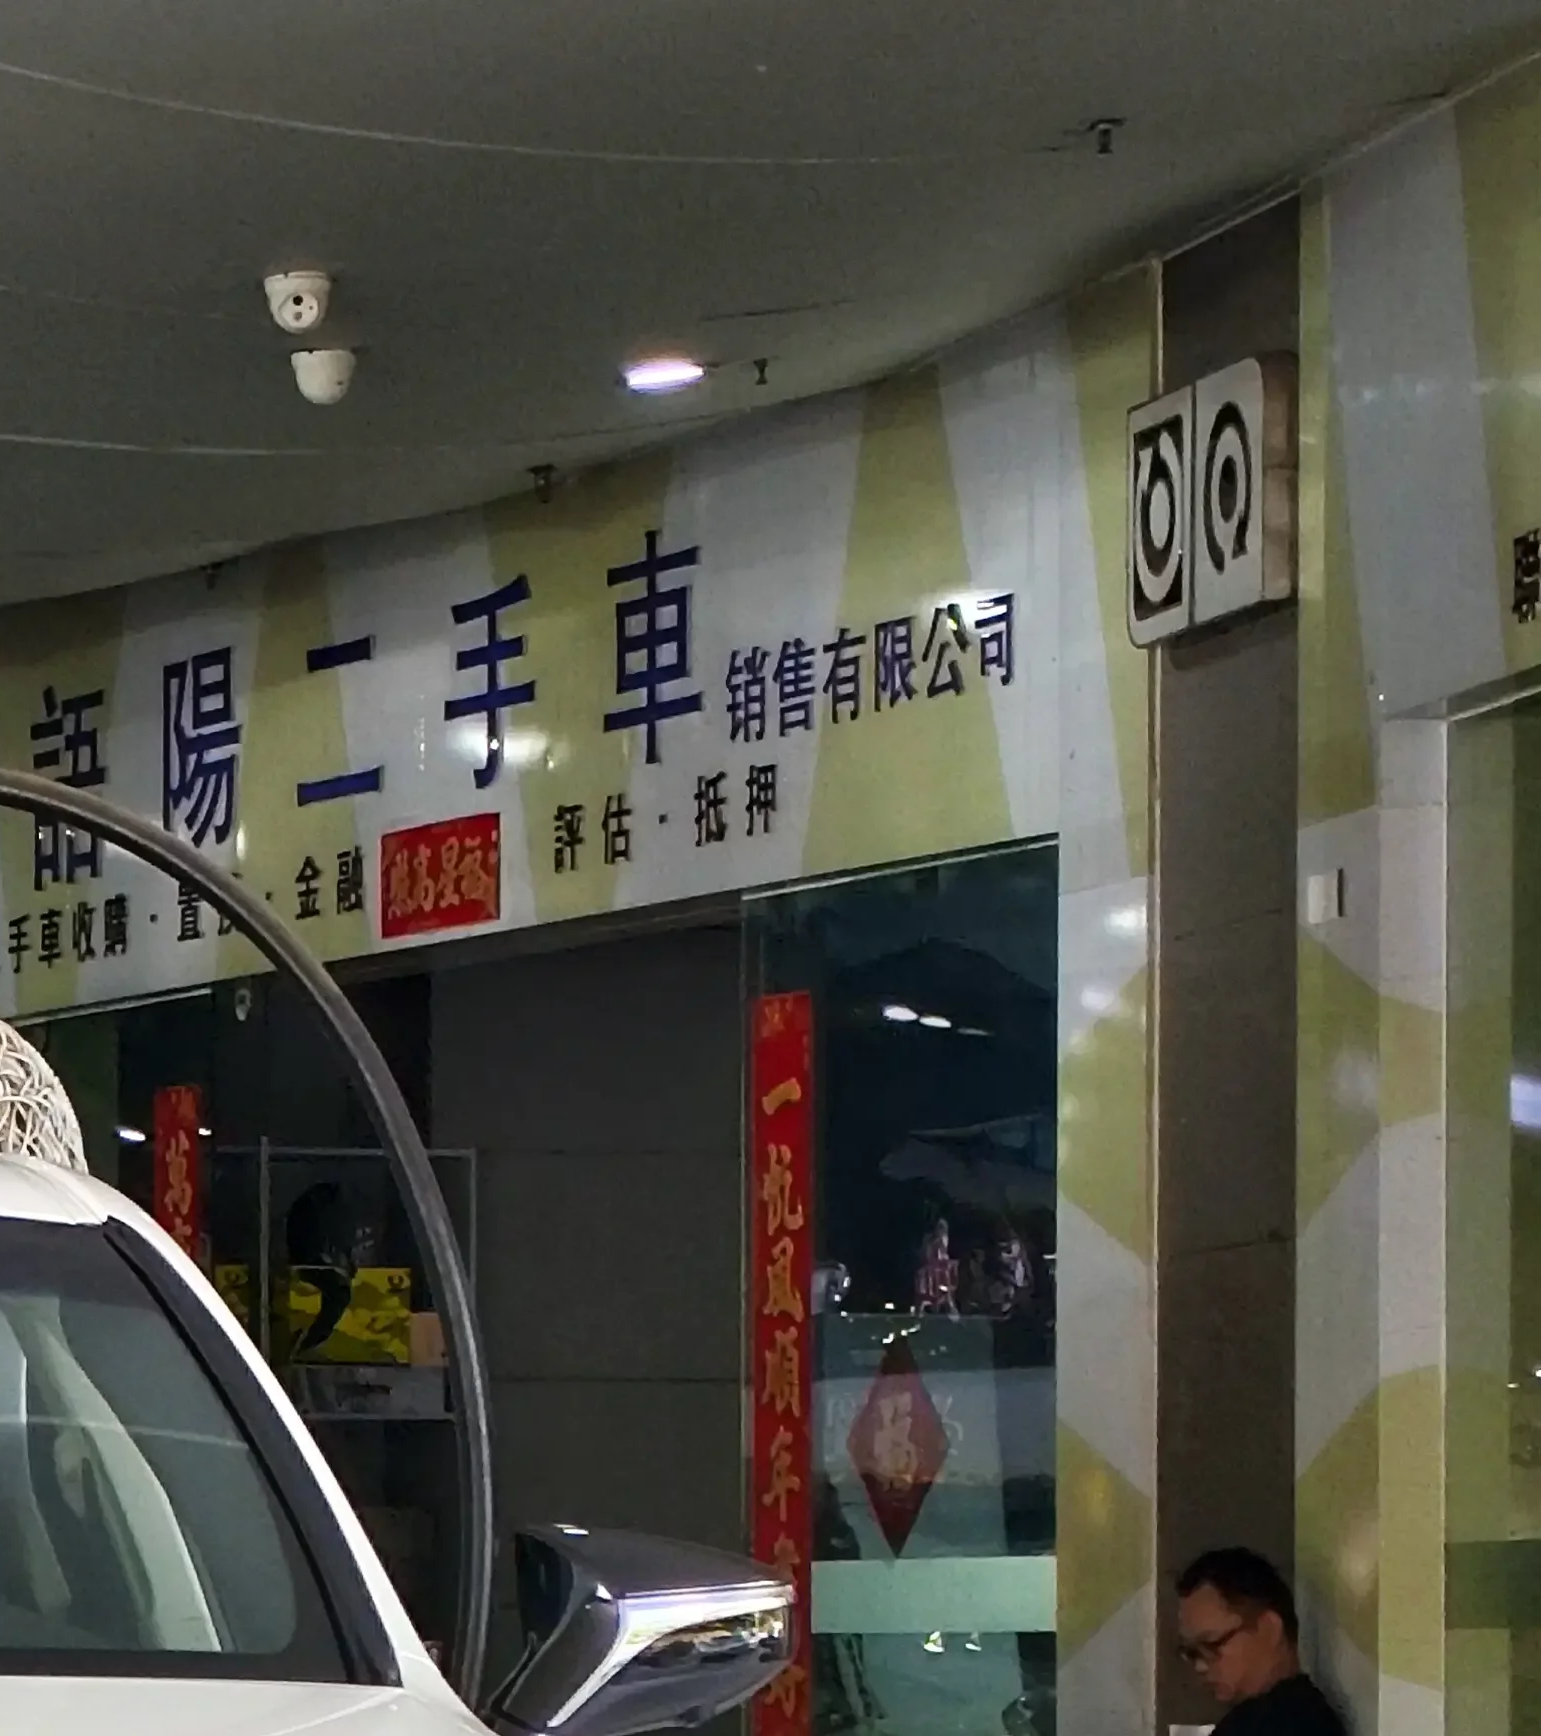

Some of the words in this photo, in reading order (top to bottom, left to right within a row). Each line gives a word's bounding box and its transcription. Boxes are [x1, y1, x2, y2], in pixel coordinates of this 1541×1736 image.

[726, 591, 1016, 743] 销售有限公司
[294, 846, 365, 922] 金融
[553, 793, 634, 874] 評估
[693, 763, 778, 848] 抵押
